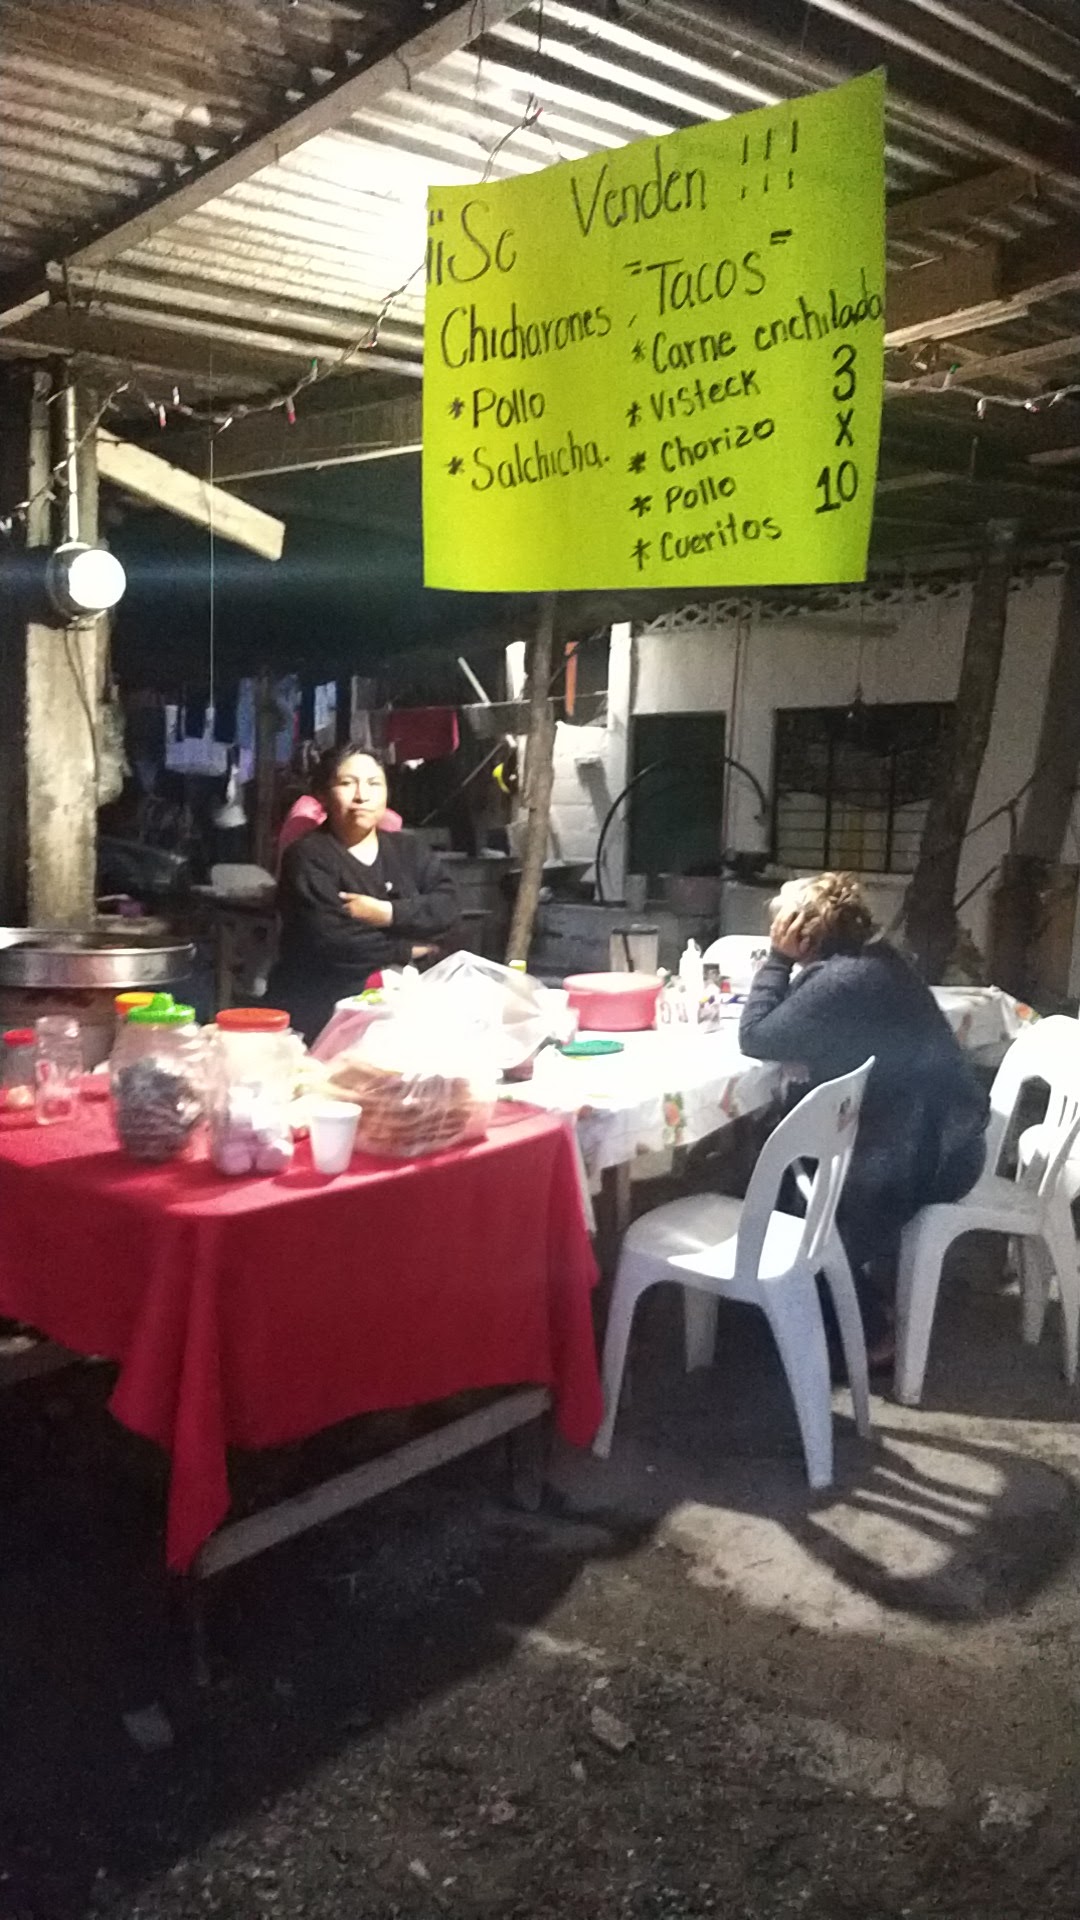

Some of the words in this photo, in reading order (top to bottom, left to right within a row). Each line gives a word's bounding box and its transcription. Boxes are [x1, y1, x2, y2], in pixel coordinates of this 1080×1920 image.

[570, 144, 707, 238] Venden
[652, 331, 737, 374] Carne
[832, 343, 857, 402] 3
[472, 387, 546, 429] Pollo
[661, 417, 775, 473] Chorizo
[665, 476, 737, 513] Pollo
[815, 459, 859, 515] 10
[660, 512, 783, 562] Cueritos
